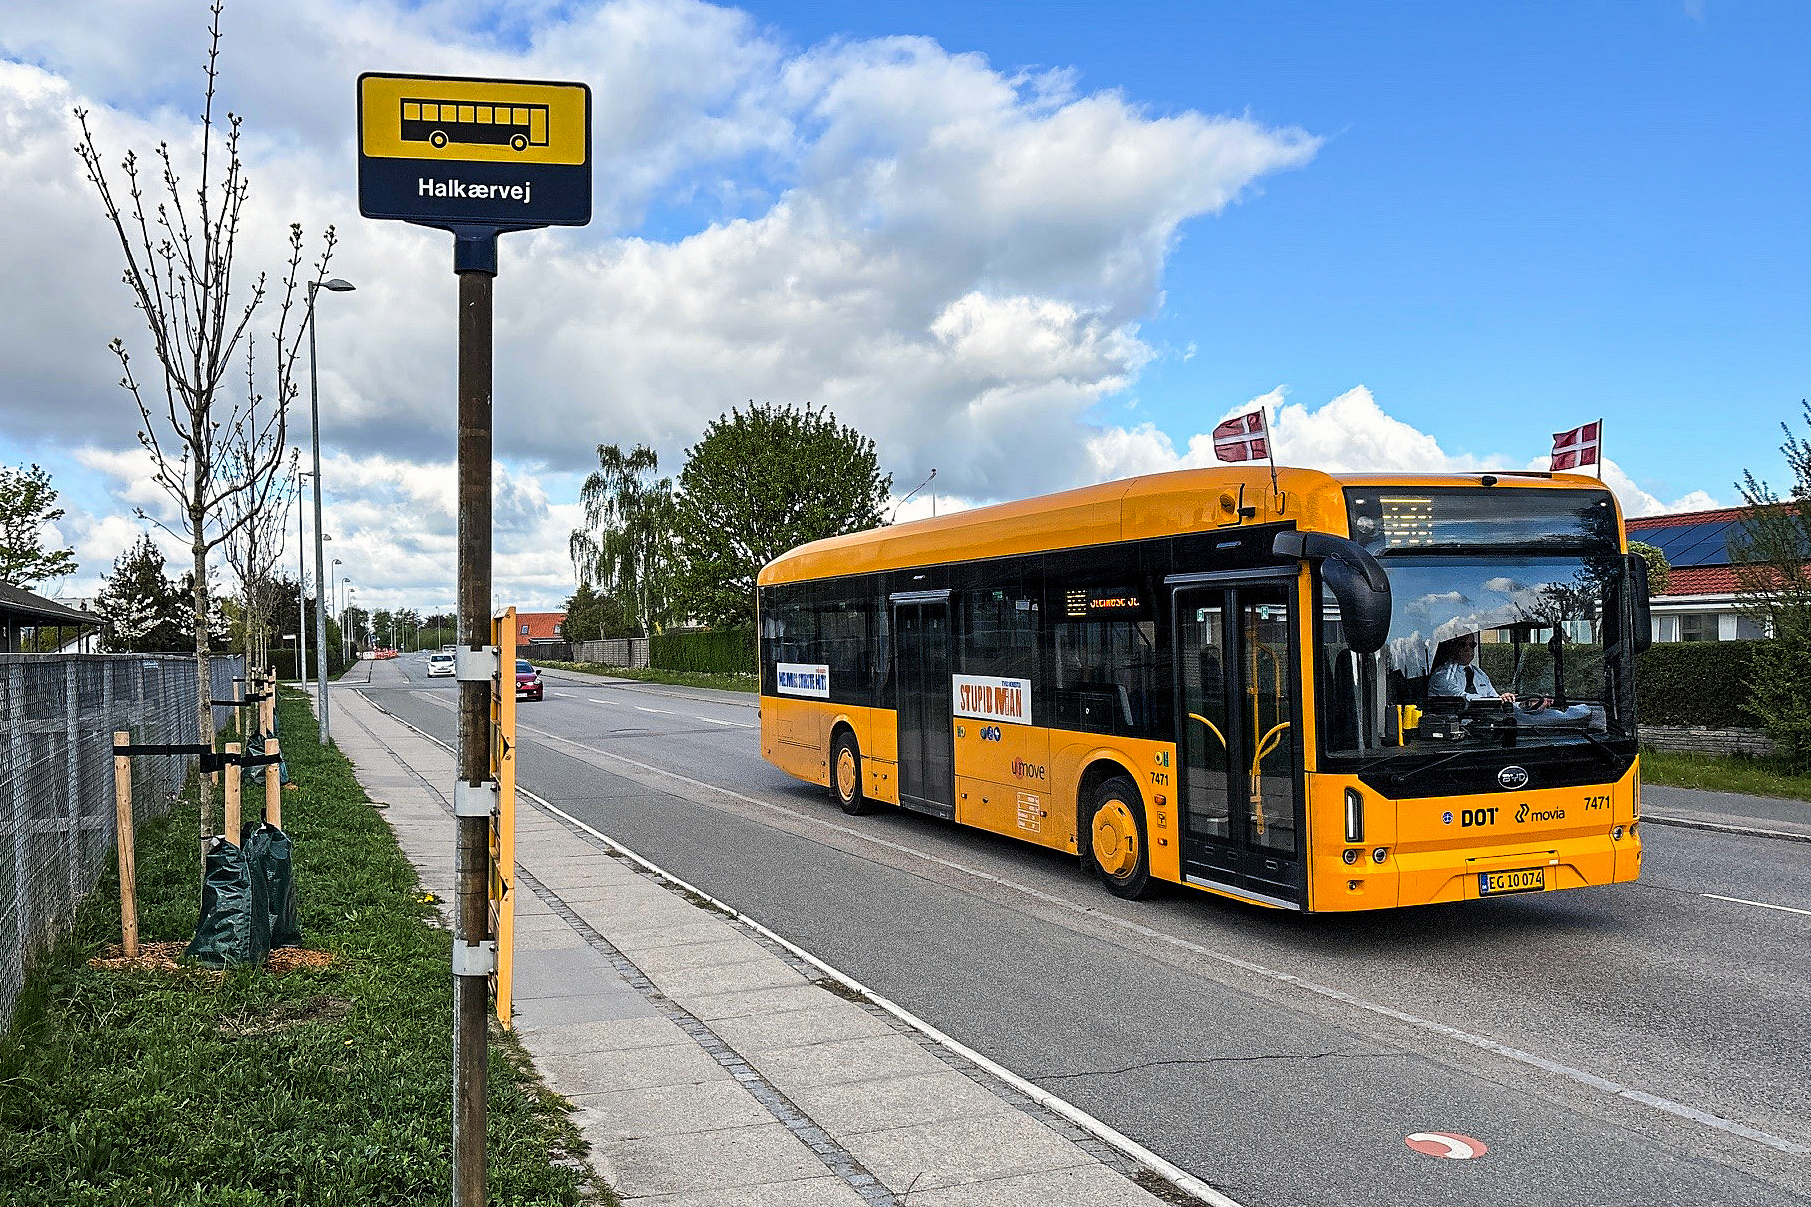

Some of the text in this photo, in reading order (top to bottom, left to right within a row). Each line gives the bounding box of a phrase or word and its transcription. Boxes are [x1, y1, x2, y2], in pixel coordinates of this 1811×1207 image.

[418, 178, 531, 204] Halkærvej
[960, 684, 992, 713] STUPID
[1150, 771, 1169, 786] 7471
[1502, 772, 1526, 783] BYD
[1584, 795, 1610, 810] 7471
[1461, 807, 1497, 827] DOT
[1531, 806, 1565, 822] movia
[1490, 876, 1504, 889] EG
[1507, 874, 1519, 887] 10
[1522, 872, 1542, 886] 074
